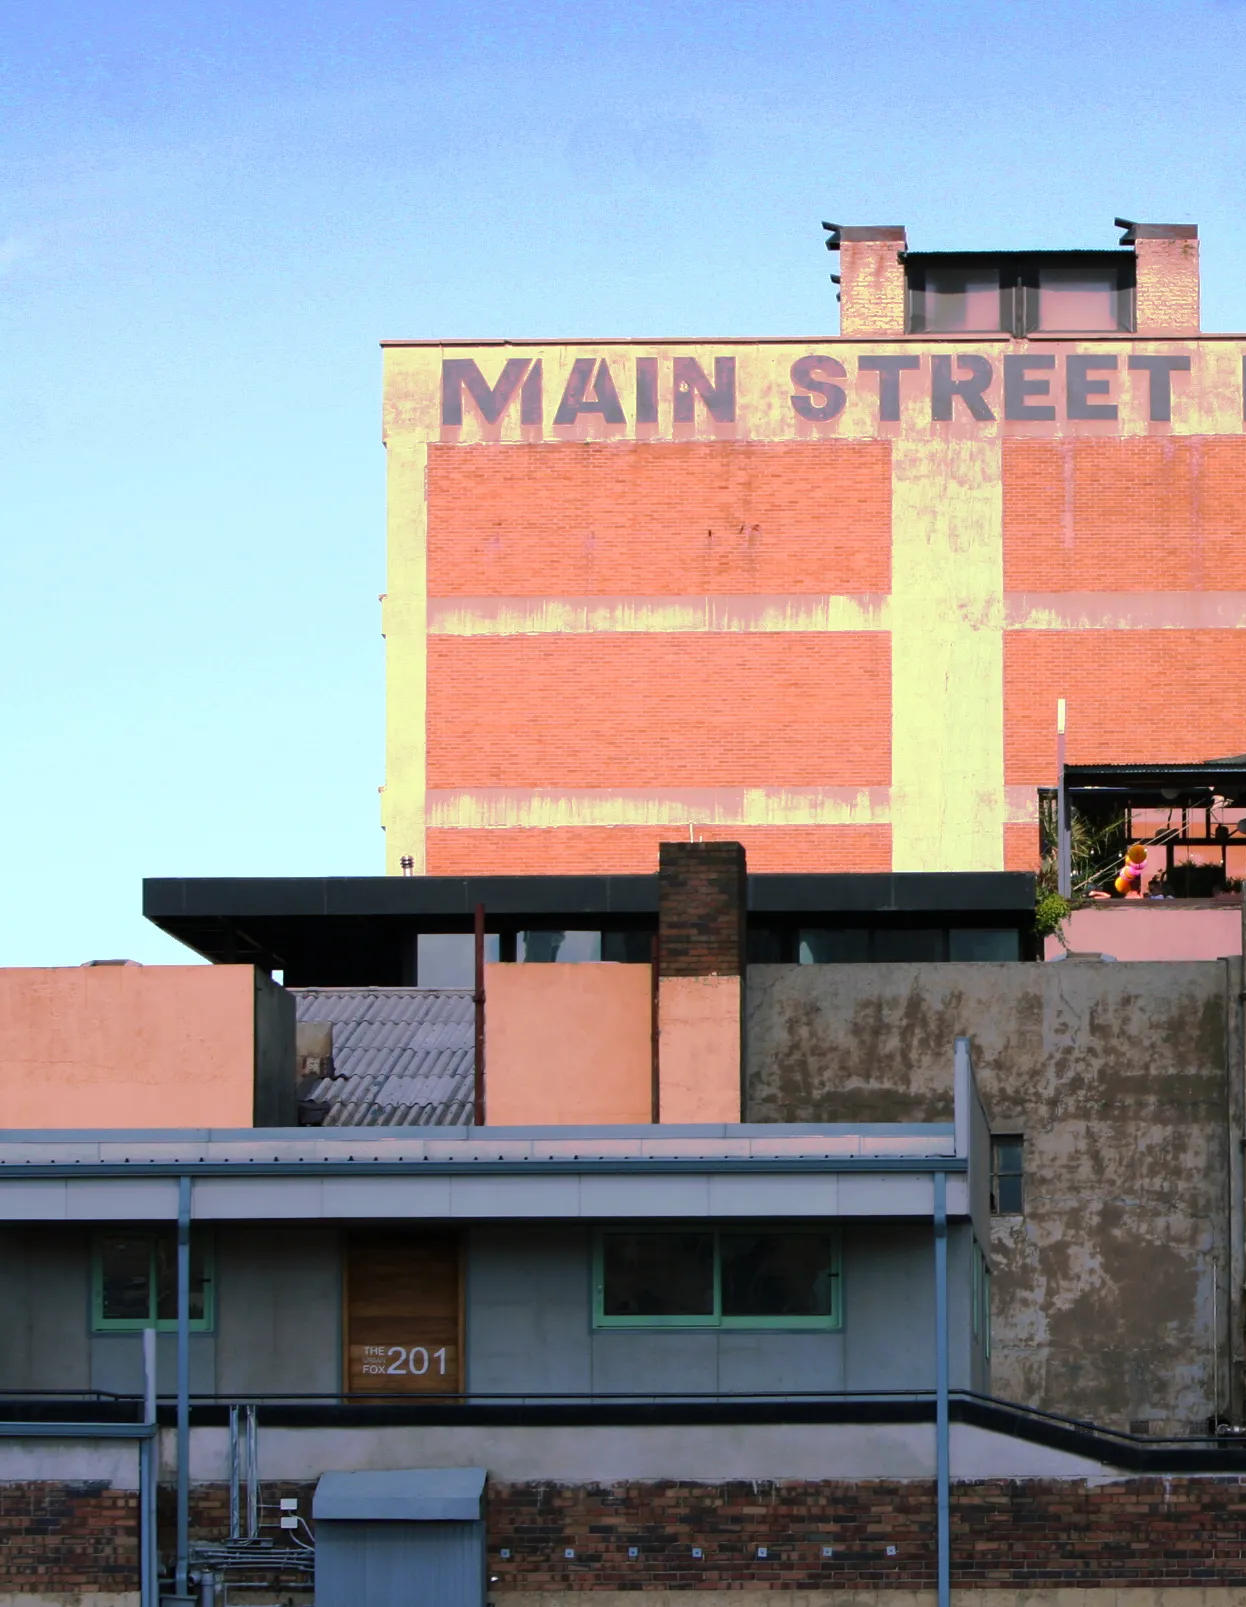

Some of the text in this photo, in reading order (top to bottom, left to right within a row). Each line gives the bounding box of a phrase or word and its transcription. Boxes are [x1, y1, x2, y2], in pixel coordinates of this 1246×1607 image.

[443, 356, 735, 426] MAIN
[790, 354, 1192, 422] STREET
[363, 1346, 385, 1356] THE
[386, 1346, 446, 1375] 201
[362, 1364, 386, 1374] FOX
